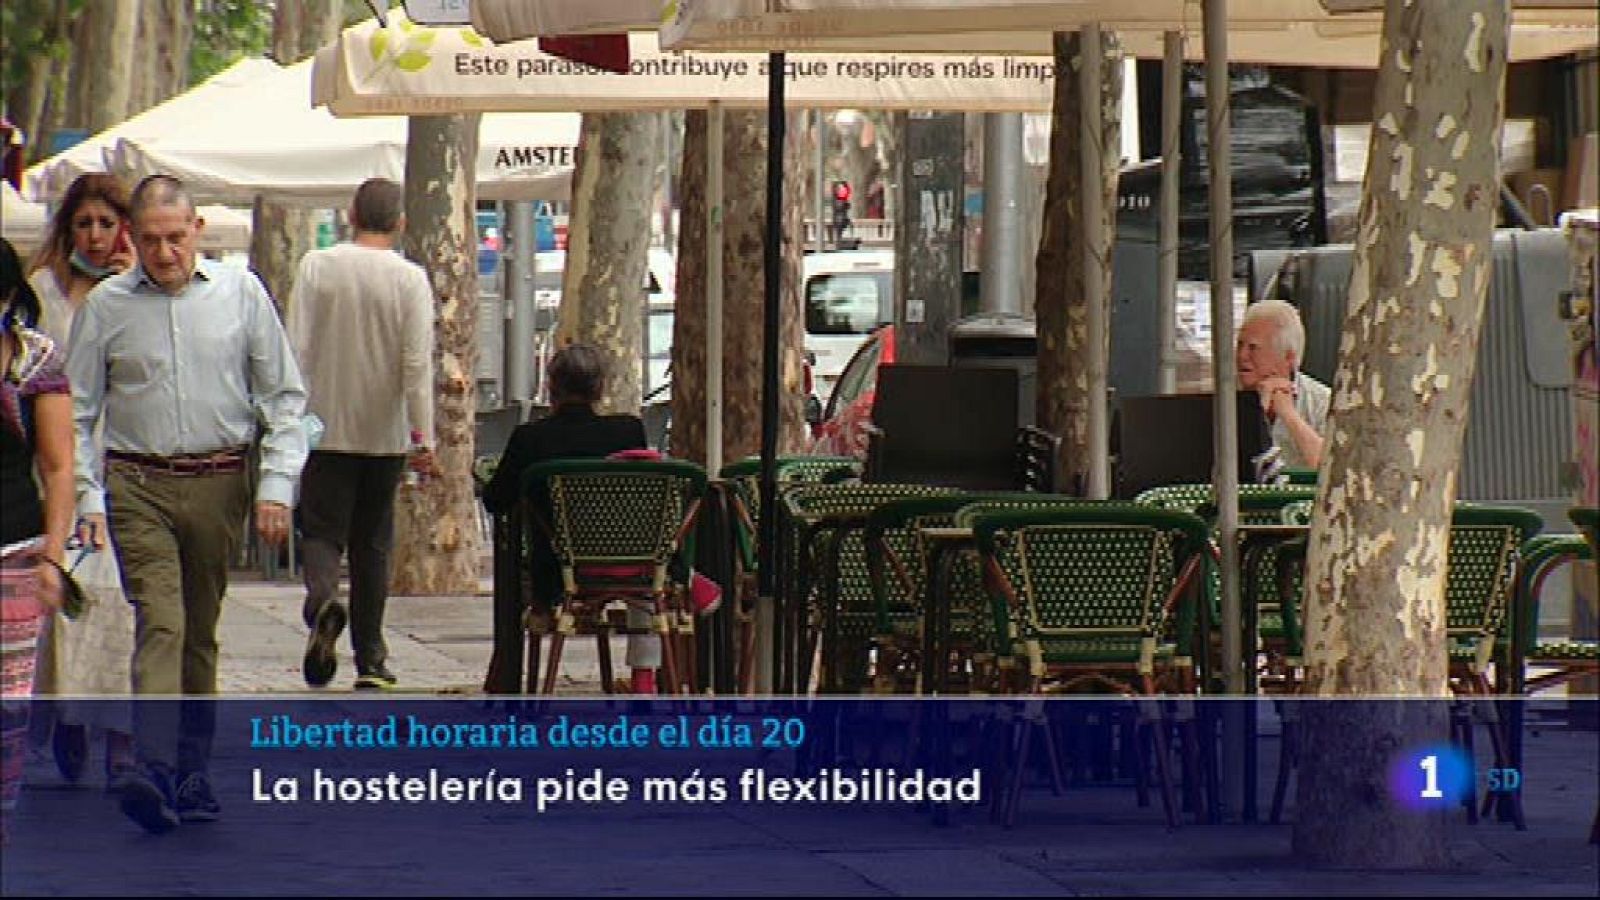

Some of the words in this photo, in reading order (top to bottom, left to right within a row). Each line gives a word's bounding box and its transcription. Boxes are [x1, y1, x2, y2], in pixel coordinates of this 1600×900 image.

[454, 53, 509, 76] Este
[630, 55, 748, 81] ontribuye
[784, 61, 828, 81] que
[836, 56, 935, 81] respires
[943, 56, 995, 78] más
[1003, 57, 1056, 84] limp
